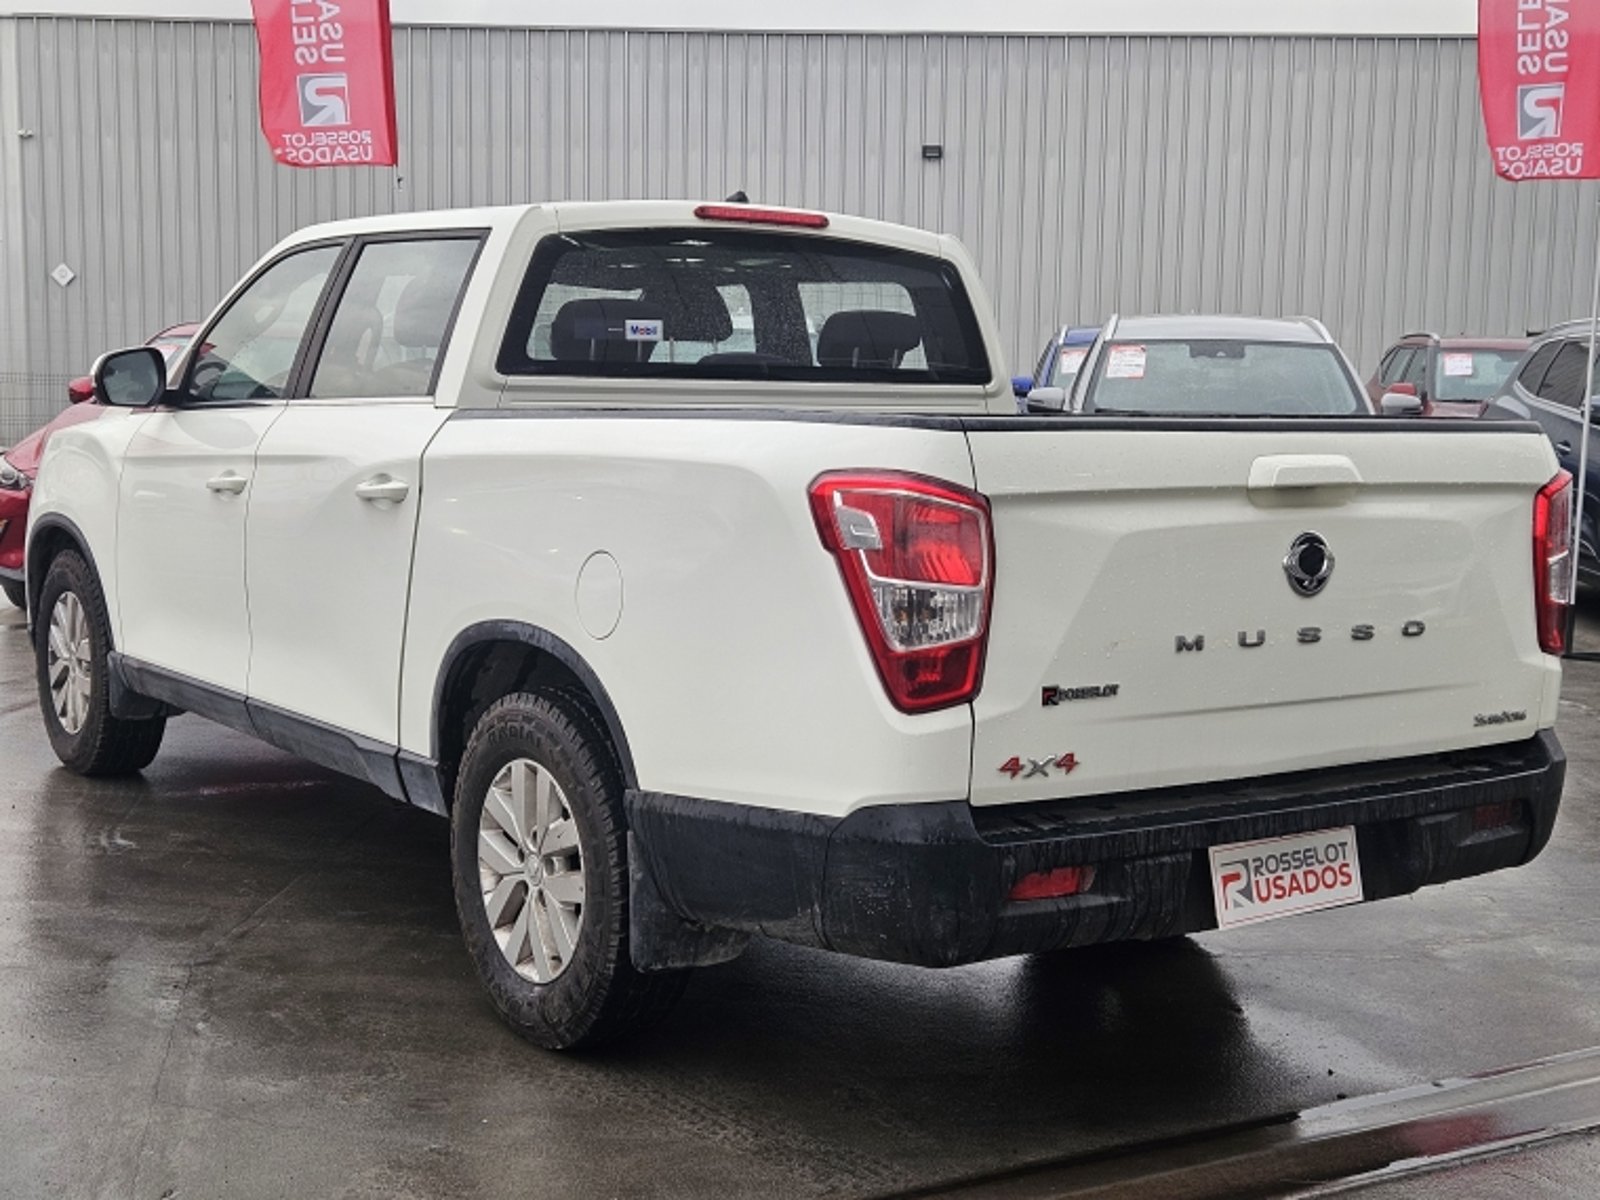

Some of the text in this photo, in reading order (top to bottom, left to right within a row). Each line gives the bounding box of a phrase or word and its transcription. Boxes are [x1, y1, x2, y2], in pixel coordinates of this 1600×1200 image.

[1174, 620, 1427, 653] MUSSO
[1252, 841, 1348, 878] ROSSELOT
[1254, 862, 1353, 904] USADOS
